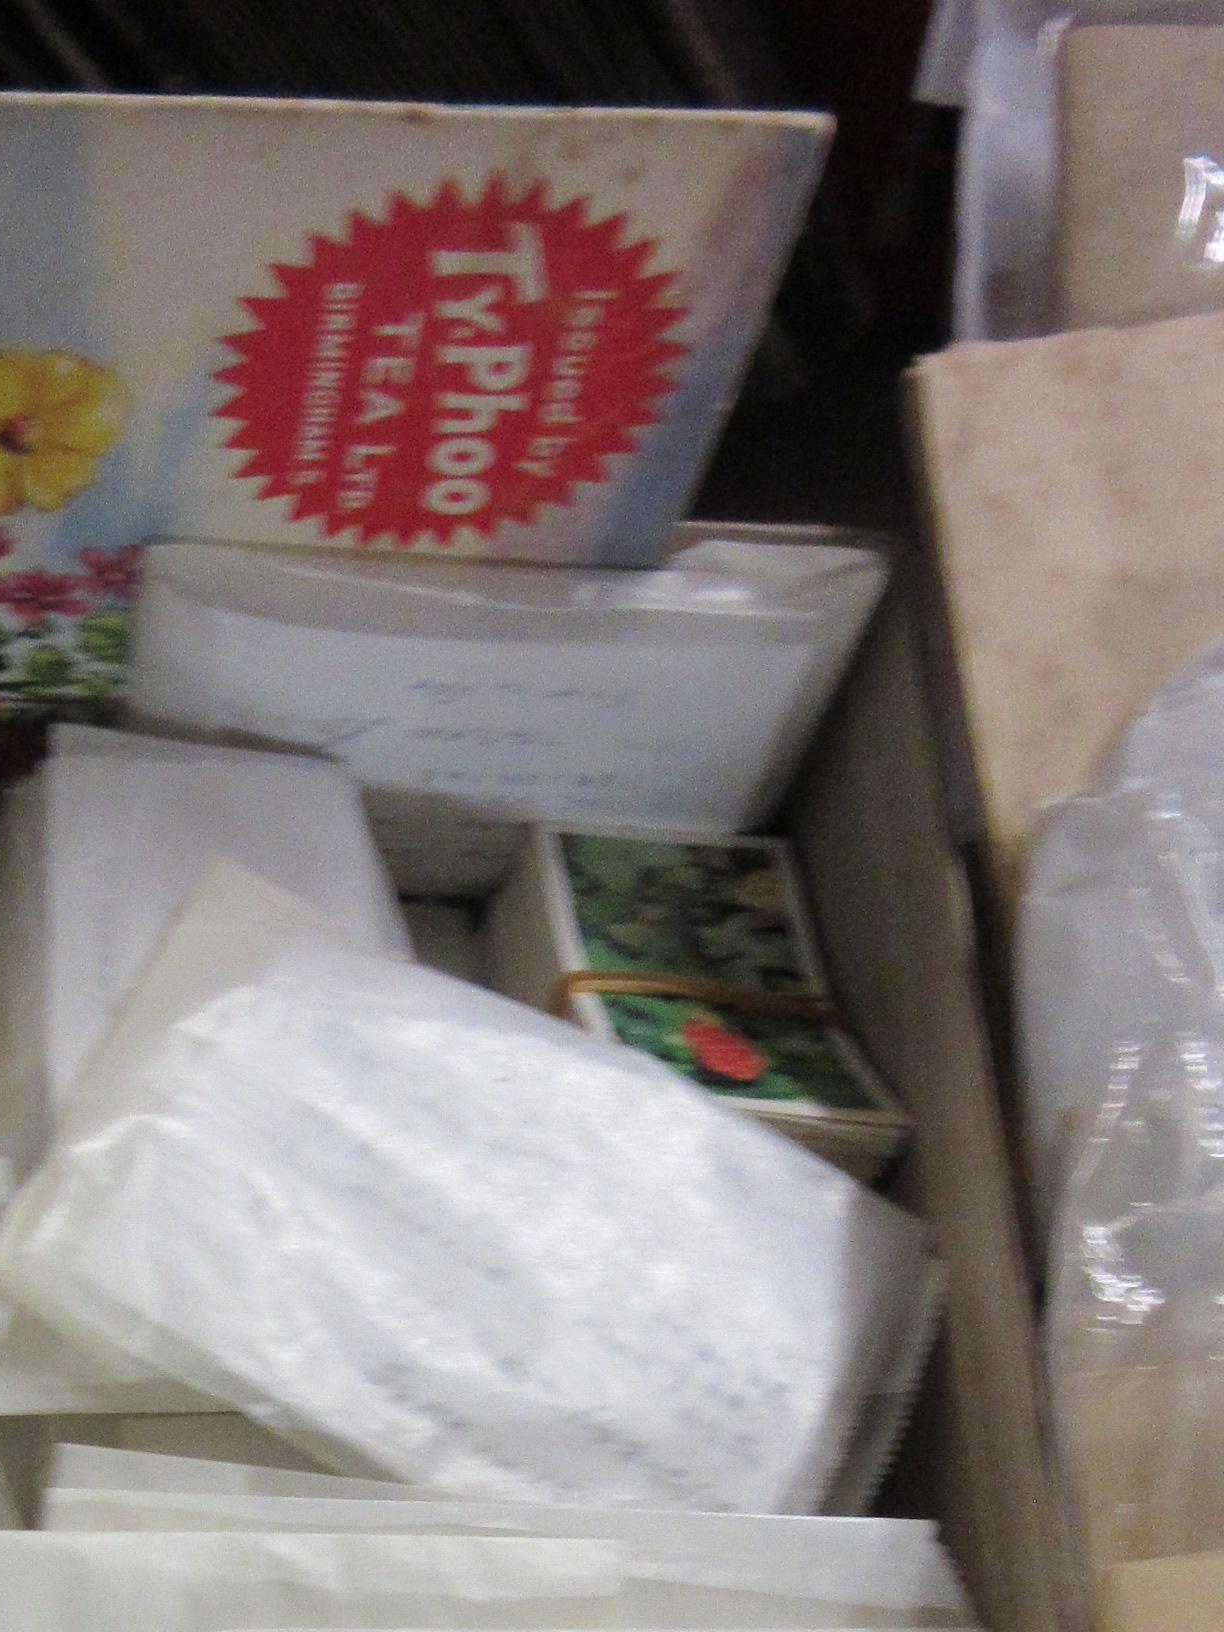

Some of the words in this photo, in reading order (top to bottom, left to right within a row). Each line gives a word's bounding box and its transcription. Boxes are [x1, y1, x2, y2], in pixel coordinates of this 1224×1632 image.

[292, 281, 366, 462] BIRMINGHAM
[352, 311, 426, 425] TEA
[534, 289, 622, 425] Issued
[514, 435, 577, 480] by
